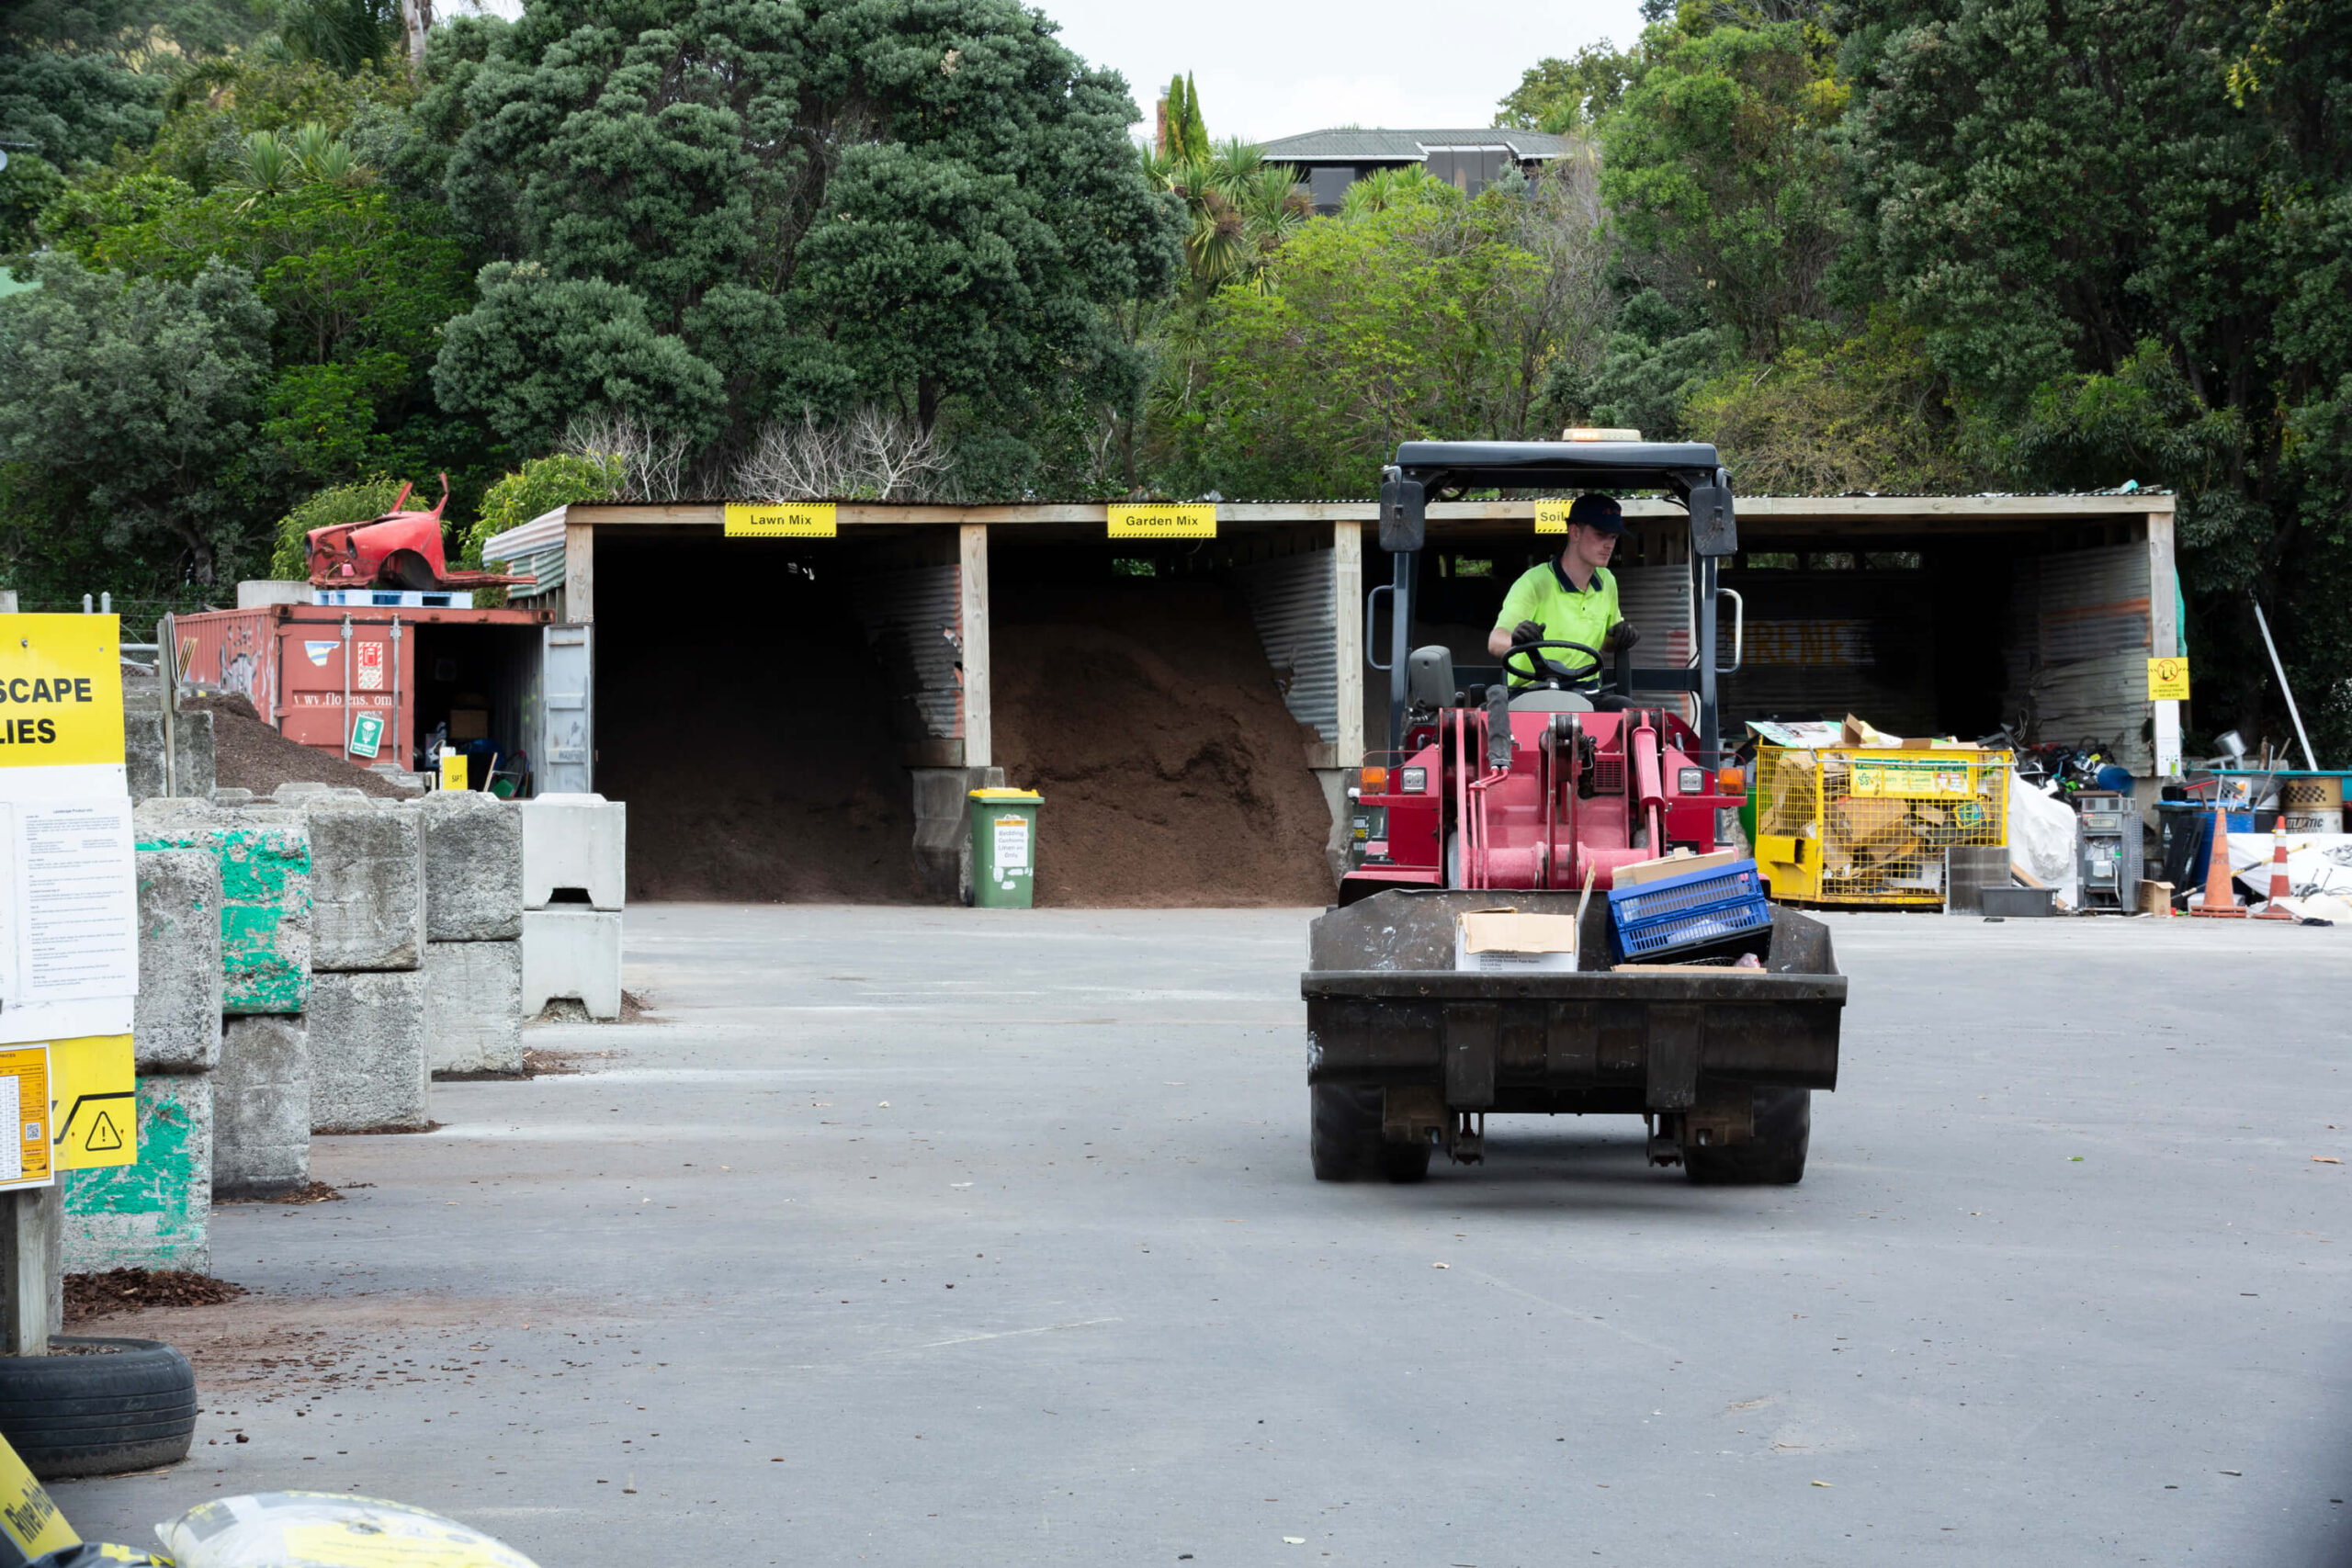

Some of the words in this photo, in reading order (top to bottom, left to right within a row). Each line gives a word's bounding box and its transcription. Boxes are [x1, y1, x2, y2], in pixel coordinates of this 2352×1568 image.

[749, 514, 785, 525] Lawn
[789, 514, 811, 525] Mix
[1125, 514, 1173, 526] Garden
[1177, 514, 1198, 526] Mix
[1540, 512, 1567, 522] Soil
